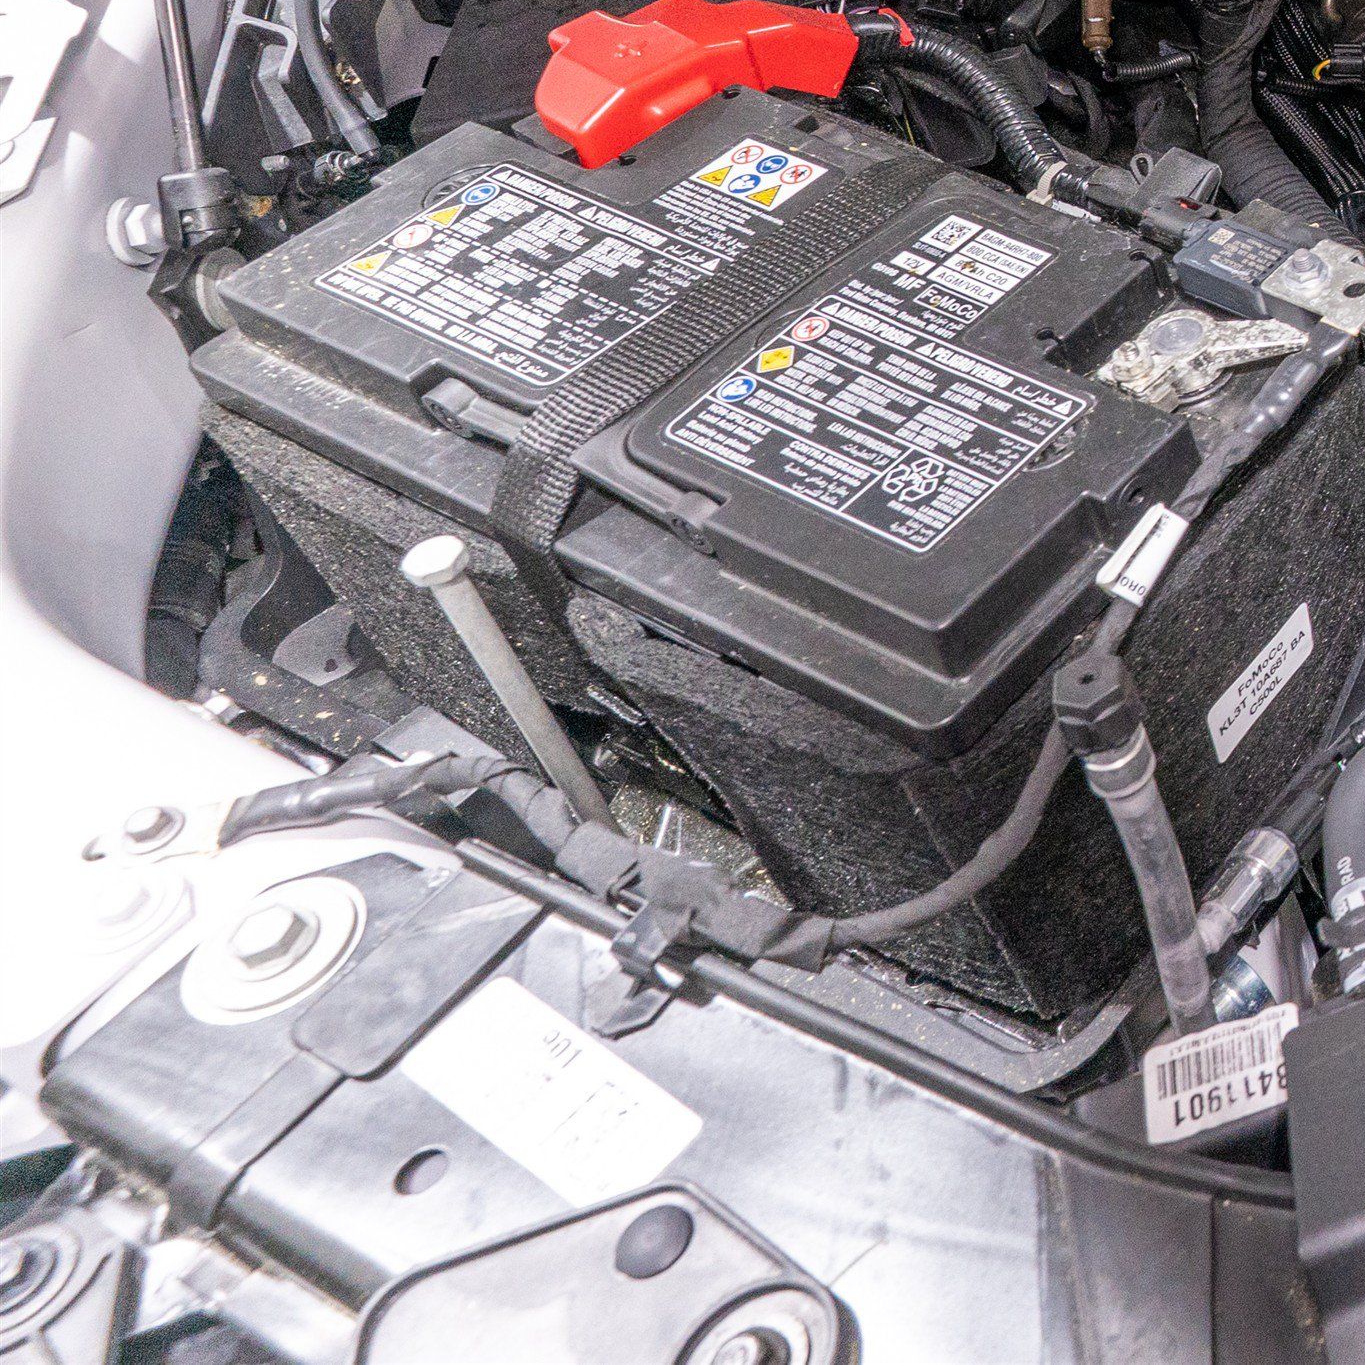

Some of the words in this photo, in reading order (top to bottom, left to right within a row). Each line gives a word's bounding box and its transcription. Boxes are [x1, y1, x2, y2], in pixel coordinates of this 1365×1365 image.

[501, 173, 581, 210] DANGER/POISON
[588, 210, 670, 247] PELIGRO/VENENO
[904, 258, 925, 269] 12V
[964, 245, 986, 256] 800
[979, 251, 1002, 263] CCA
[892, 274, 926, 290] MF
[935, 270, 996, 300] AGM/VRLA
[983, 272, 1009, 286] C20
[918, 287, 981, 321] FoMoCo
[831, 306, 919, 347] DANGER/POISON
[926, 347, 1016, 389] PELIGRO/VENENO
[1220, 697, 1248, 736] KL3T
[1290, 630, 1305, 650] BA
[1238, 642, 1283, 696] FoMoCo
[1249, 675, 1282, 715] C500L
